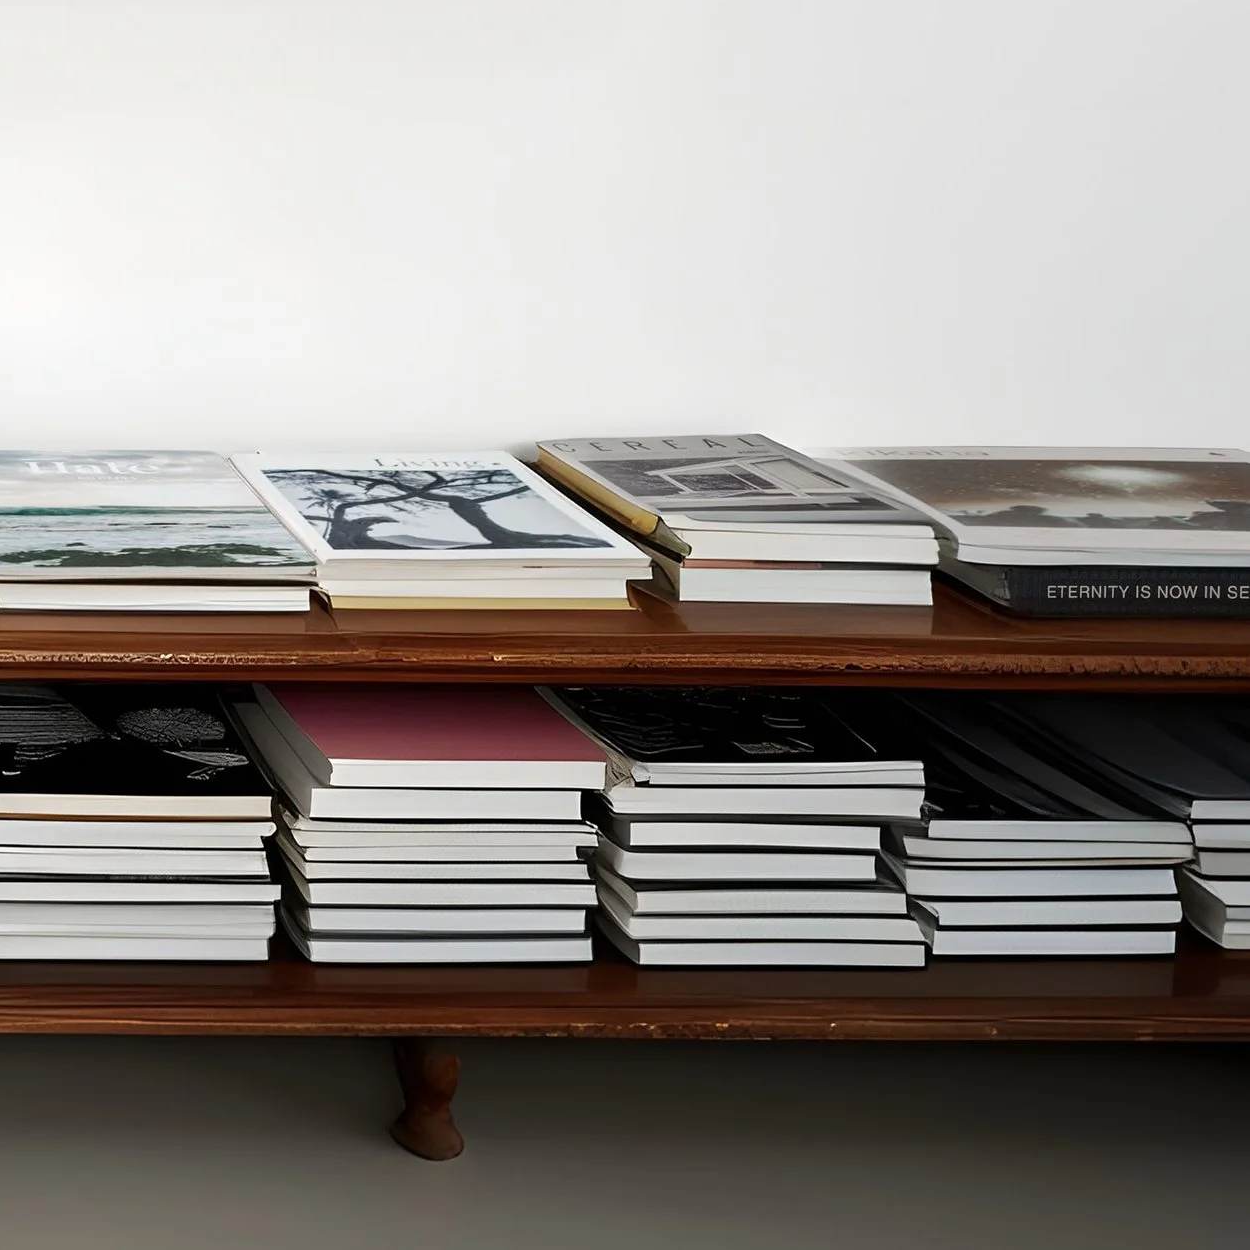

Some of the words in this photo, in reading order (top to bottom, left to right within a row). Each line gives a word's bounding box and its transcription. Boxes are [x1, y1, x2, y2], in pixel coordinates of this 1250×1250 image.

[551, 436, 765, 453] CEREAL
[374, 457, 486, 469] Living
[1047, 585, 1130, 599] ETERNITY
[1135, 585, 1151, 599] IS
[1157, 585, 1198, 599] NOW
[1204, 585, 1221, 599] IN
